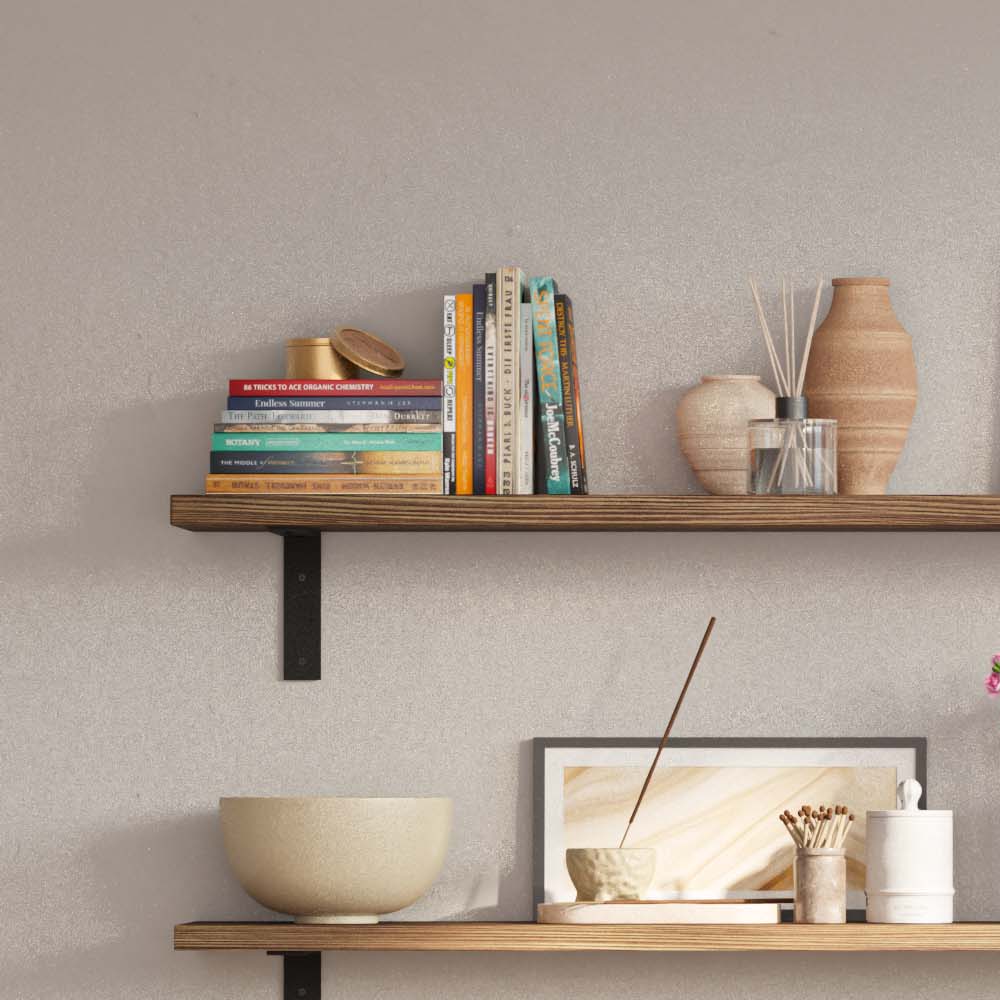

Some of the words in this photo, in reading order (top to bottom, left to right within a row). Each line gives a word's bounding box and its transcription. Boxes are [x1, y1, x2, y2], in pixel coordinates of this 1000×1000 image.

[504, 290, 512, 317] FRAU
[475, 312, 484, 345] Endless
[504, 323, 512, 352] ERSTE
[504, 359, 512, 374] DIE
[335, 383, 374, 391] CHEMISTRY
[255, 399, 287, 407] Endless
[504, 388, 512, 416] BUCK
[570, 460, 579, 489] SCHULZ
